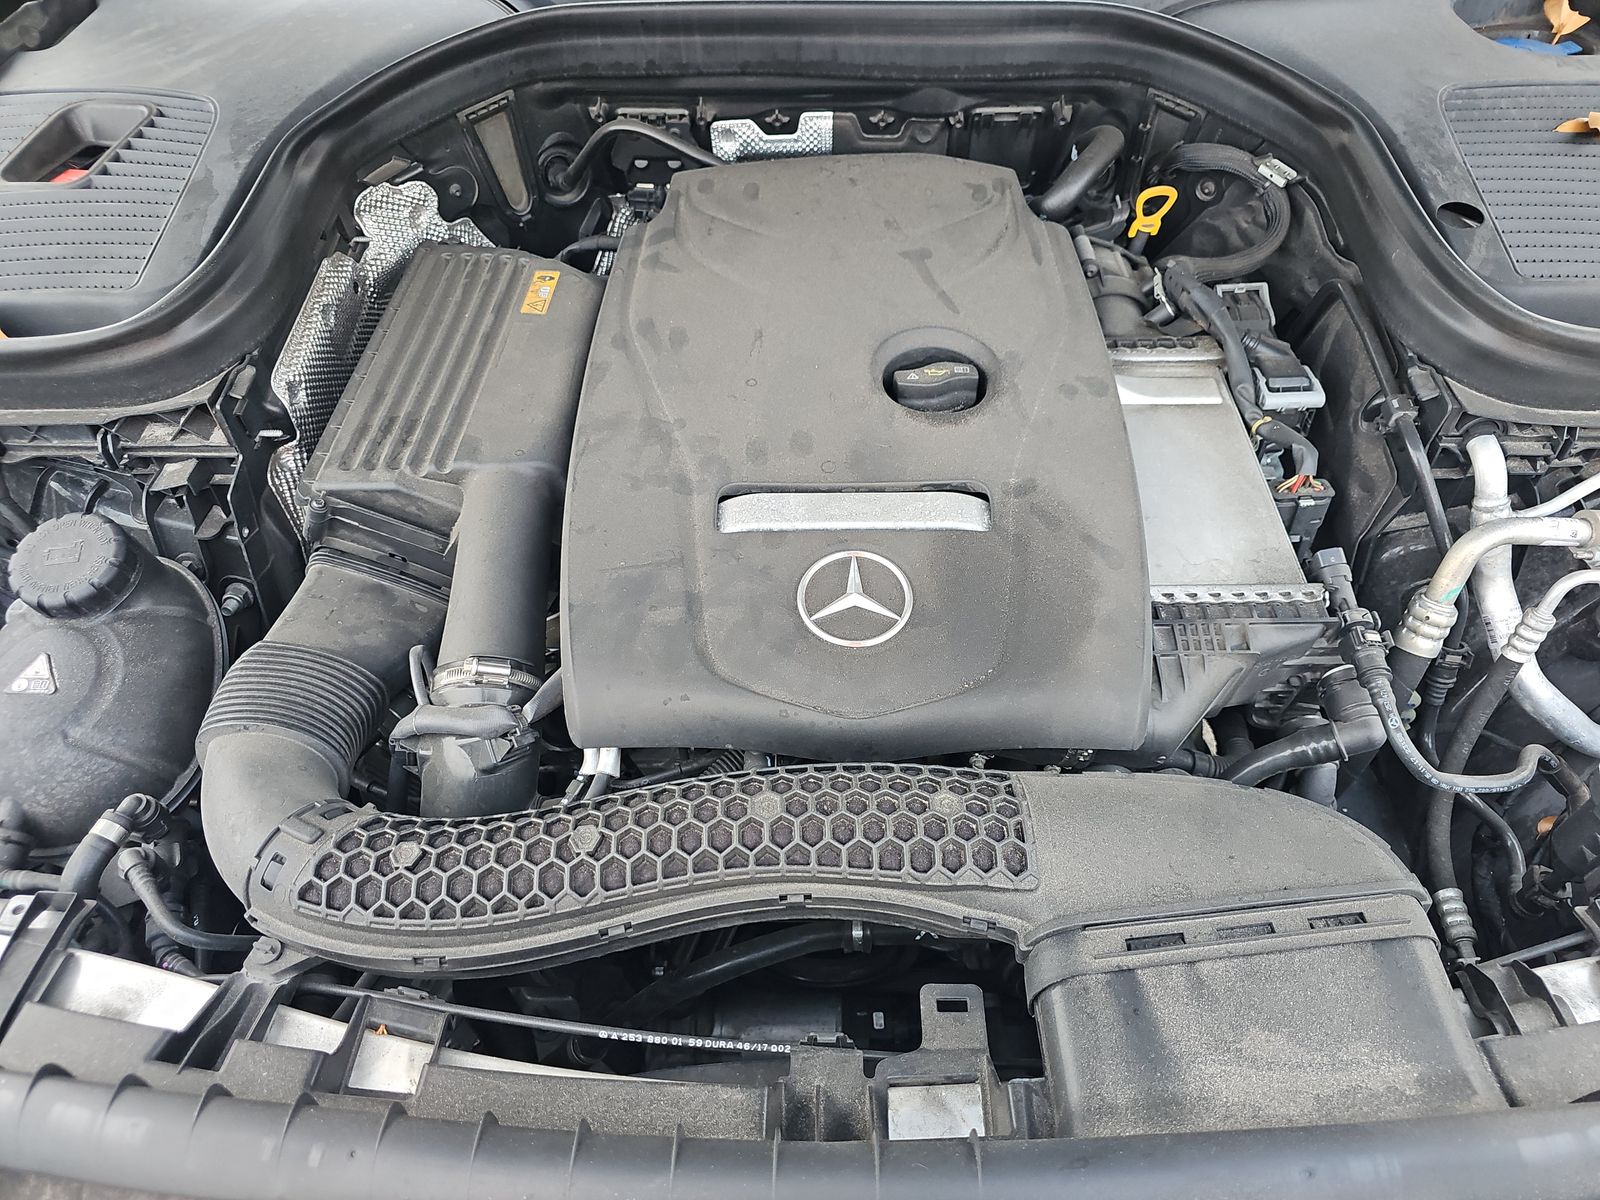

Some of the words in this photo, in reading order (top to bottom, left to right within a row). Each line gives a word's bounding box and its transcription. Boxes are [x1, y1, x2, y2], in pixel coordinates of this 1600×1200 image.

[610, 1031, 619, 1040] A
[621, 1032, 643, 1043] 253
[647, 1035, 668, 1045] 880
[671, 1036, 683, 1046] 01
[688, 1038, 703, 1047] 59
[705, 1039, 735, 1050] DURA
[736, 1041, 769, 1052] 46/17
